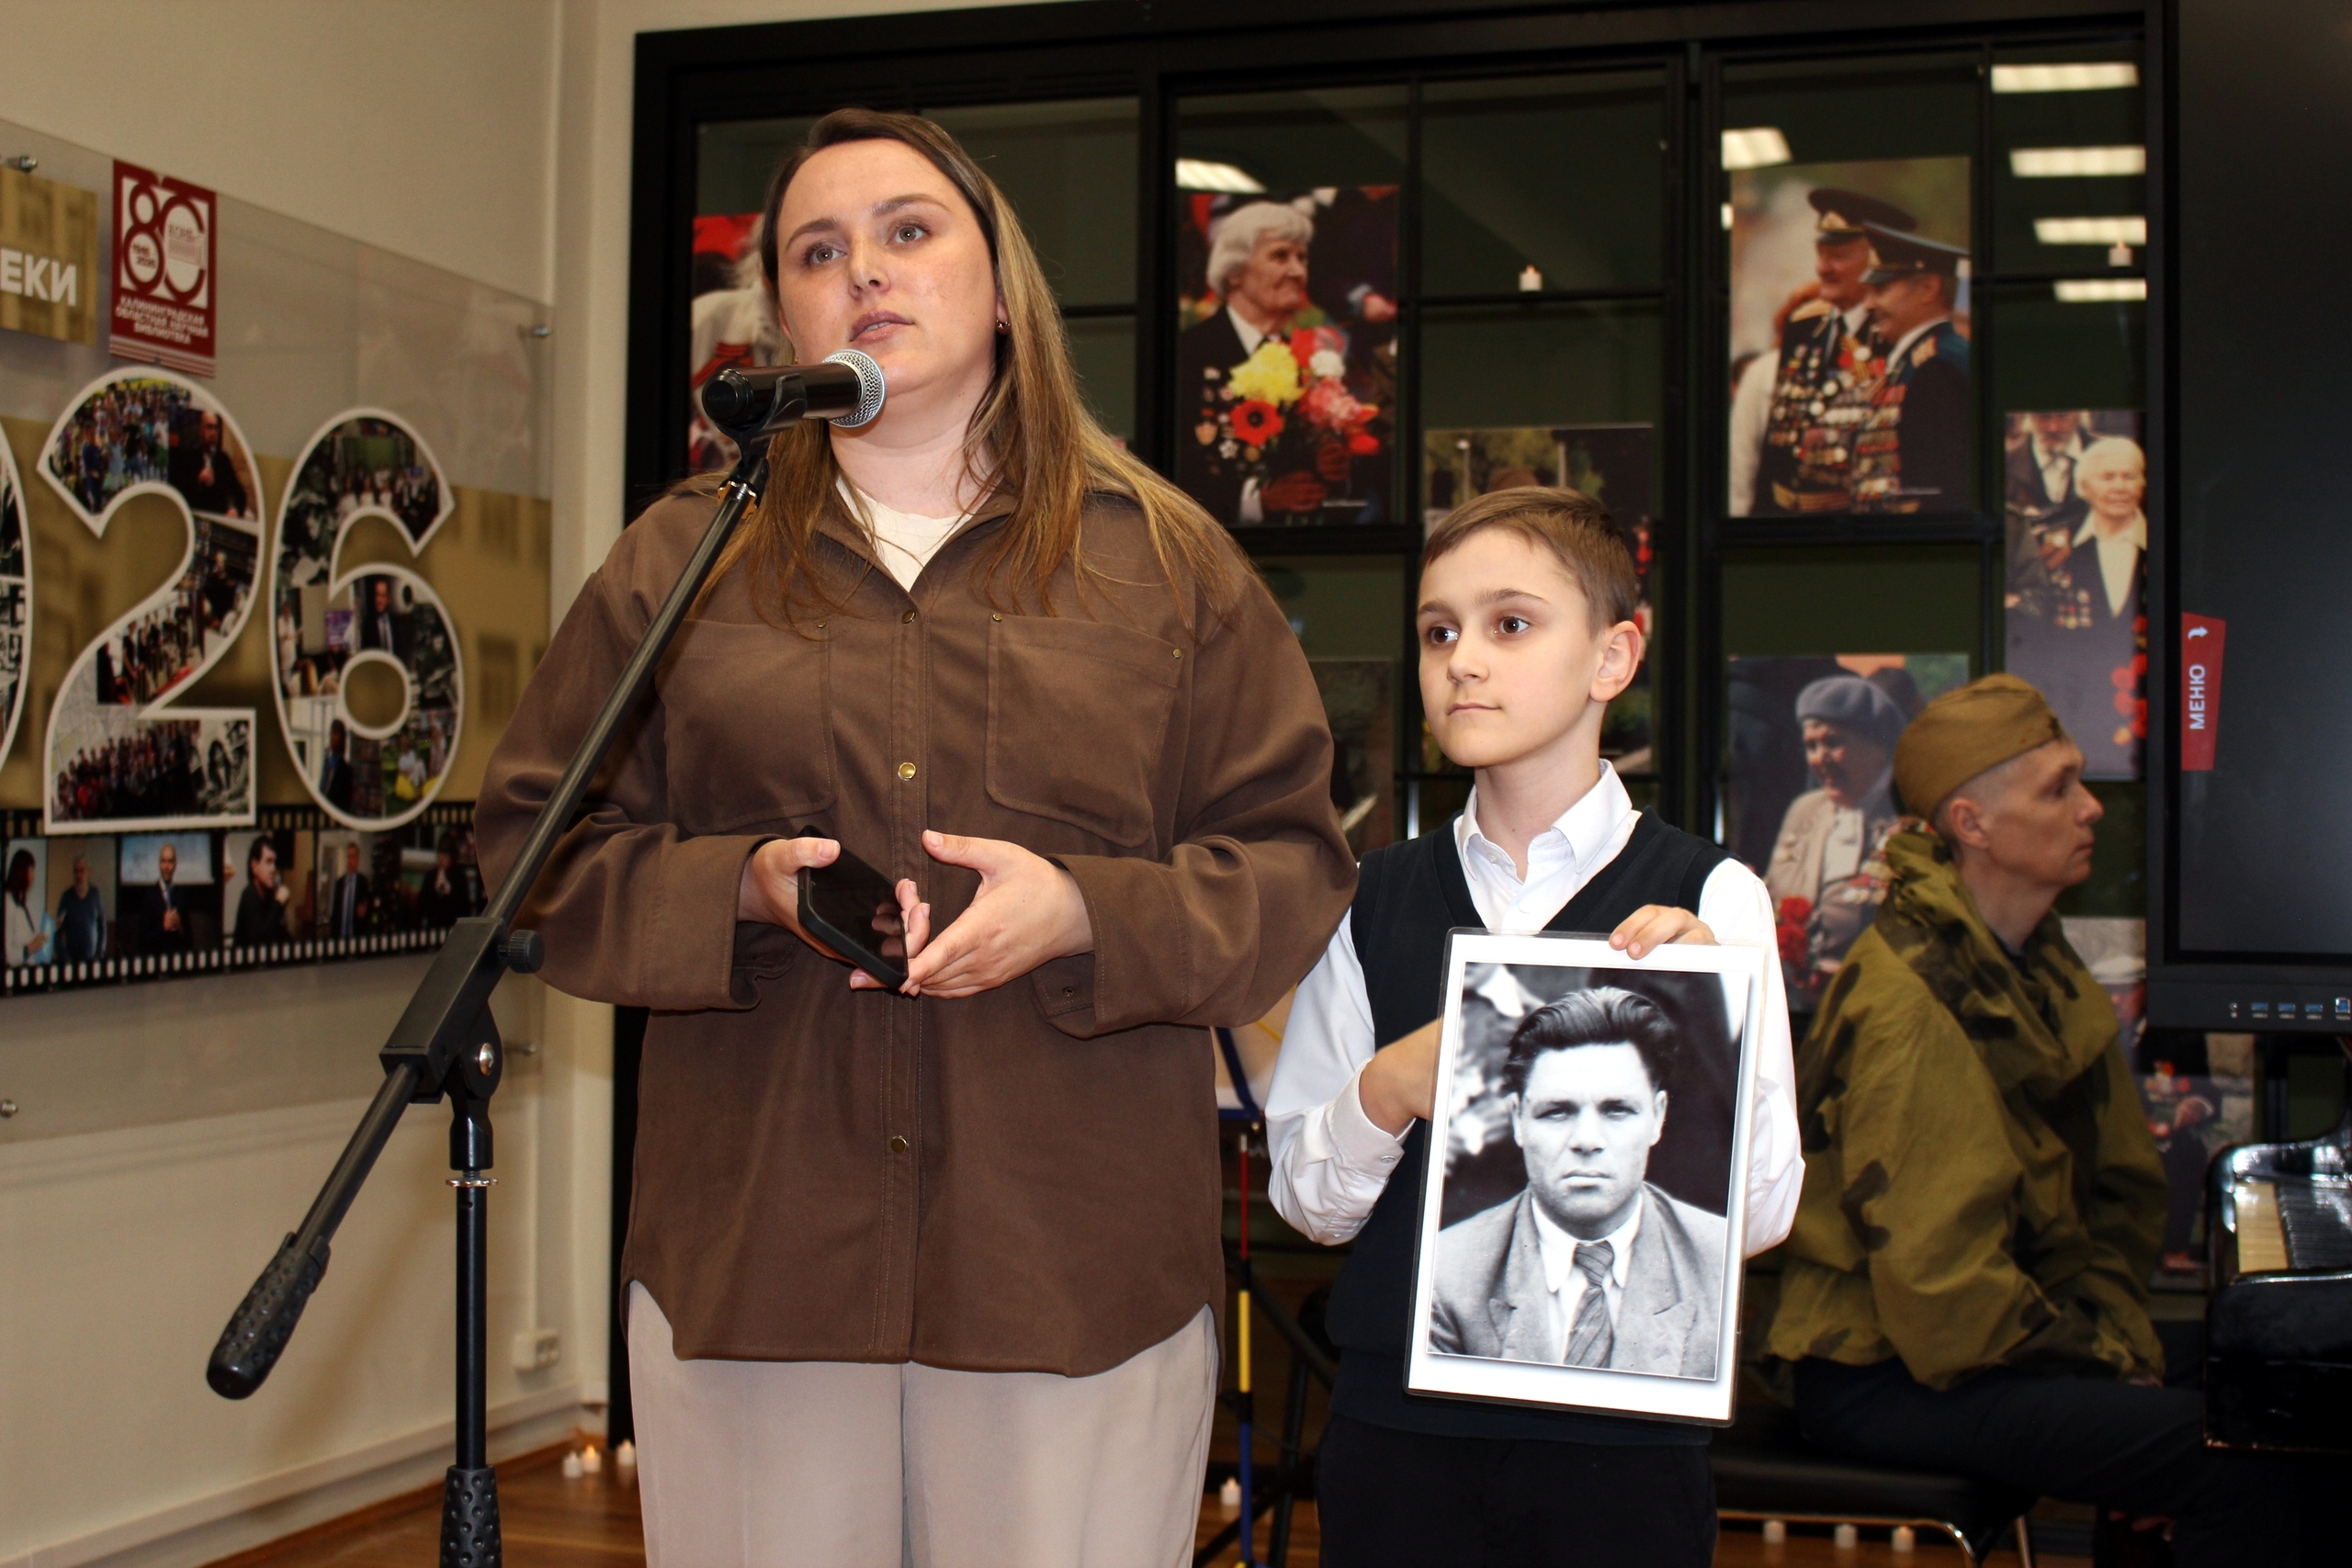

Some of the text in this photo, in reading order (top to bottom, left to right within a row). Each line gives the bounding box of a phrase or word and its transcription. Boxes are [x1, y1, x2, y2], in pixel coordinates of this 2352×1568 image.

[0, 247, 77, 307] ЕКИ
[0, 367, 464, 834] 26
[2189, 664, 2206, 729] МЕНЮ
